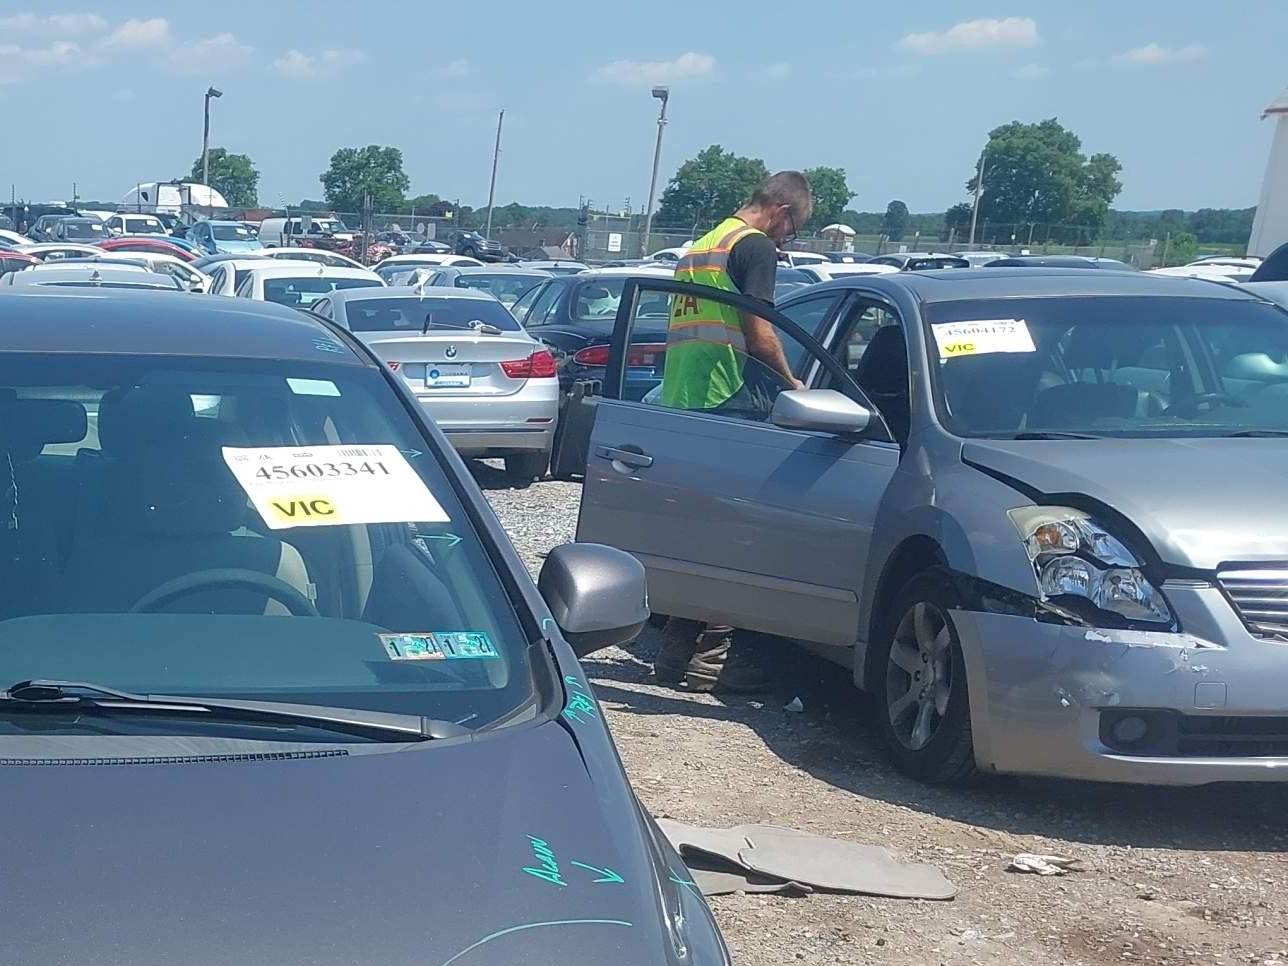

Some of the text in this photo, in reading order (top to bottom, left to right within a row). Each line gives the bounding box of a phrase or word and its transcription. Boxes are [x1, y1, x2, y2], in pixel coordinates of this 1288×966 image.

[944, 343, 975, 353] VIC
[255, 461, 391, 480] 45603341
[271, 499, 335, 517] VIC
